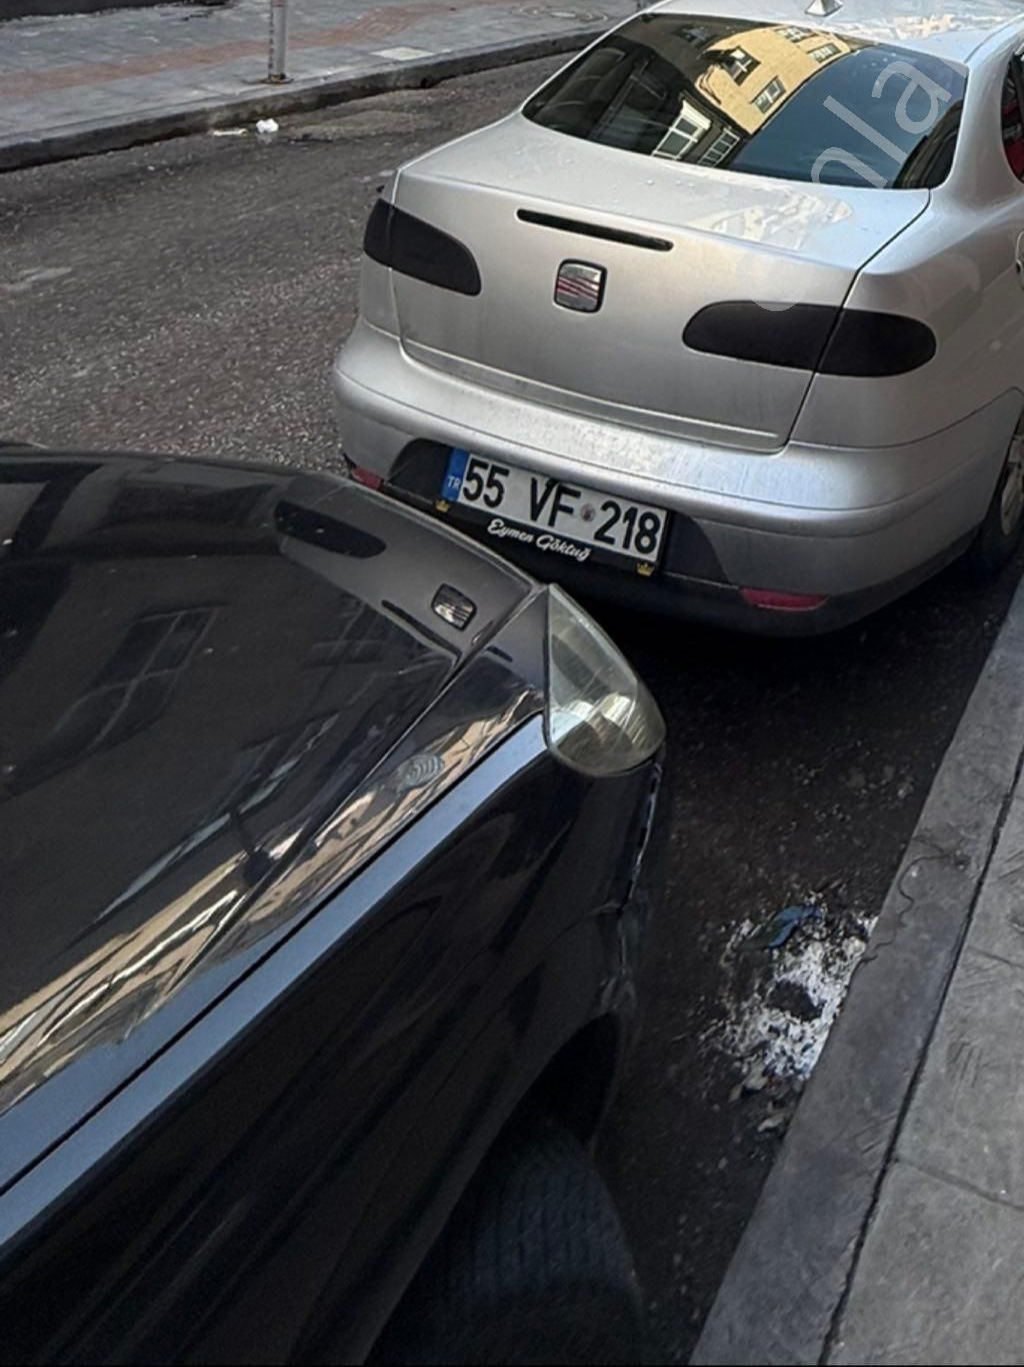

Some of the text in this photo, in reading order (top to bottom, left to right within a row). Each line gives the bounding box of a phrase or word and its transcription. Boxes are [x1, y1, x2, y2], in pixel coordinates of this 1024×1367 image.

[447, 475, 461, 491] TR
[463, 458, 660, 554] 55 VF 218
[487, 518, 534, 543] Eymen
